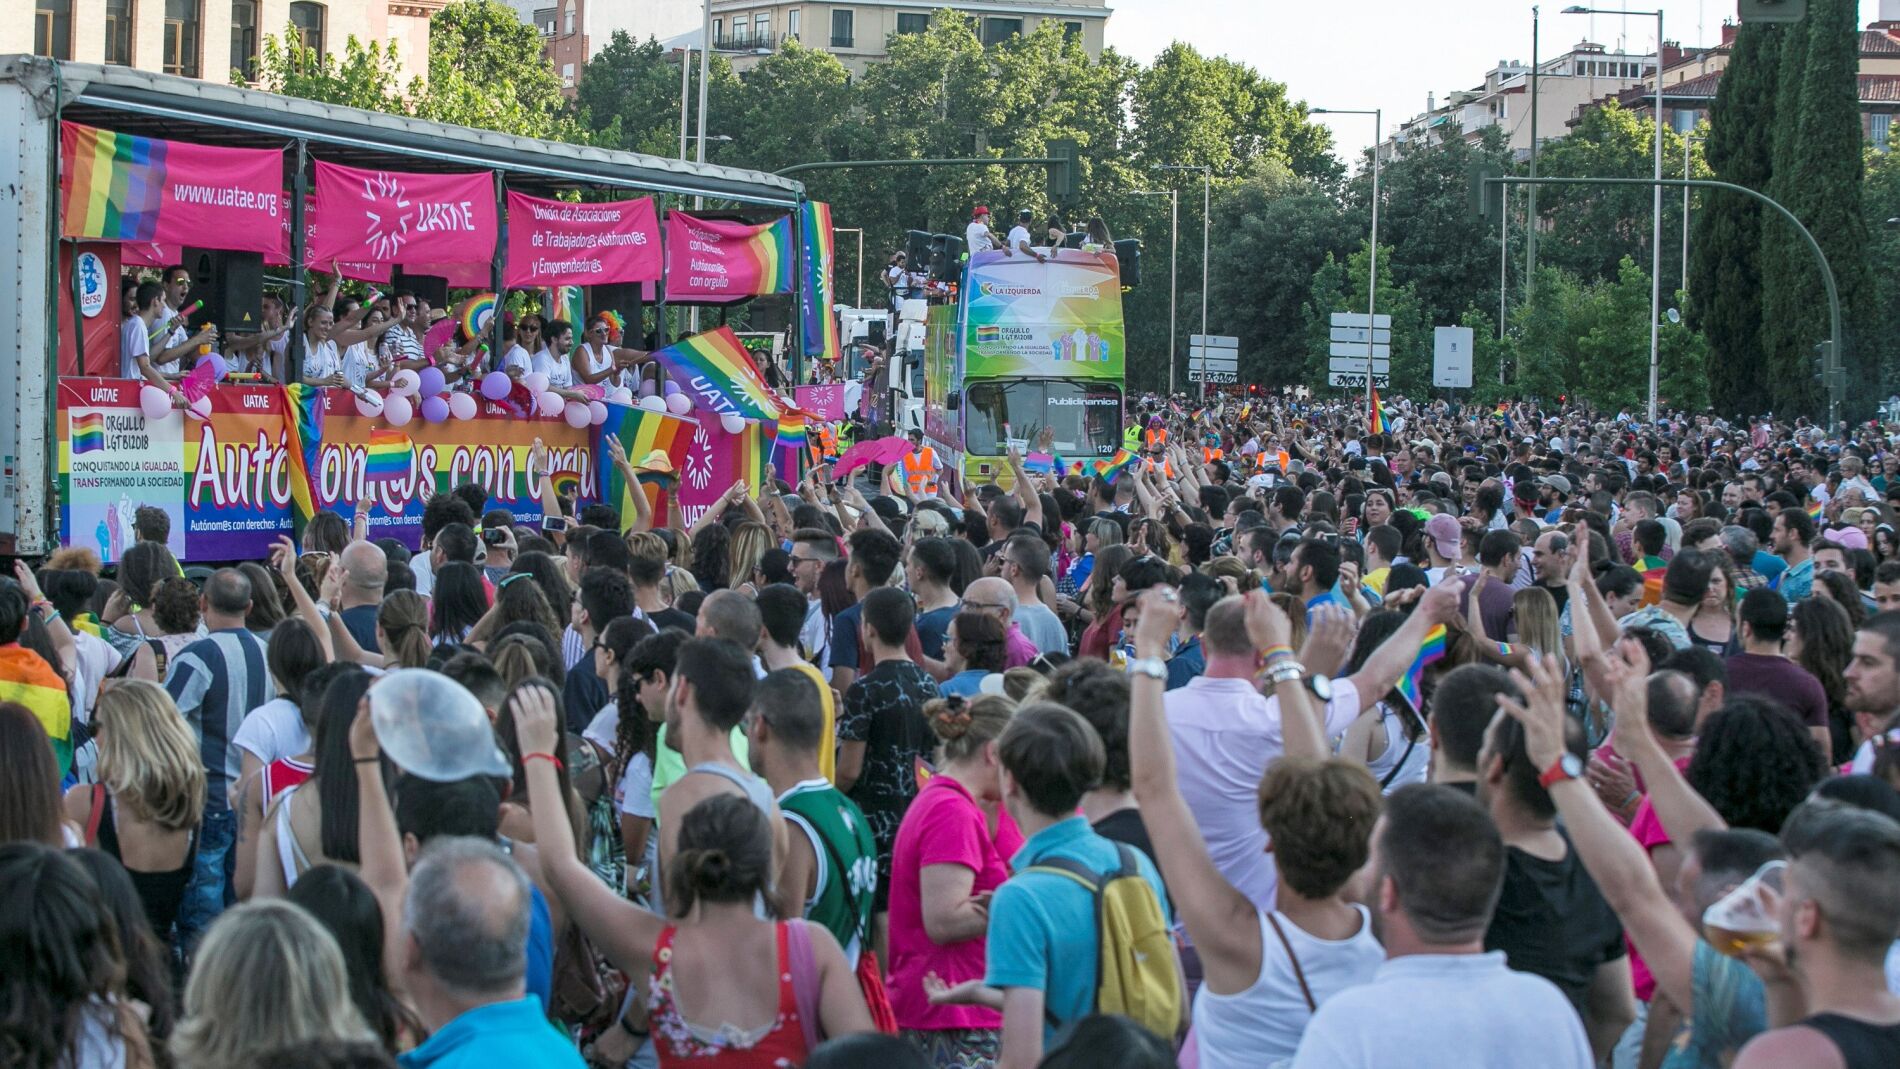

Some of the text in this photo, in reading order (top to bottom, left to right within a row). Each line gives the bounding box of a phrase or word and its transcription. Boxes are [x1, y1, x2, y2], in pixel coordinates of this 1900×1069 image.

[174, 183, 277, 217] www.uatae.org
[416, 201, 475, 232] UATAE
[532, 204, 621, 222] Unión de Asociaciones
[532, 230, 543, 247] de
[545, 230, 597, 251] Trabajador@s
[532, 257, 603, 278] y Emprendedor@s
[689, 274, 728, 290] con orgullo
[90, 388, 118, 402] UATAE
[243, 394, 269, 409] UATAE
[1048, 397, 1118, 406] Publidinamica
[105, 415, 145, 433] ORGULLO
[106, 434, 149, 451] LGTBI2018
[1097, 445, 1112, 453] 120
[72, 461, 130, 473] CONQUISTANDO
[131, 462, 140, 471] LA
[451, 446, 516, 501] con
[73, 477, 184, 488] TRANSFORMANDO LA SOCIEDAD
[190, 519, 231, 531] Autónom@s
[232, 520, 245, 530] con
[246, 518, 275, 530] derechos
[392, 515, 403, 525] con
[532, 513, 541, 521] con
